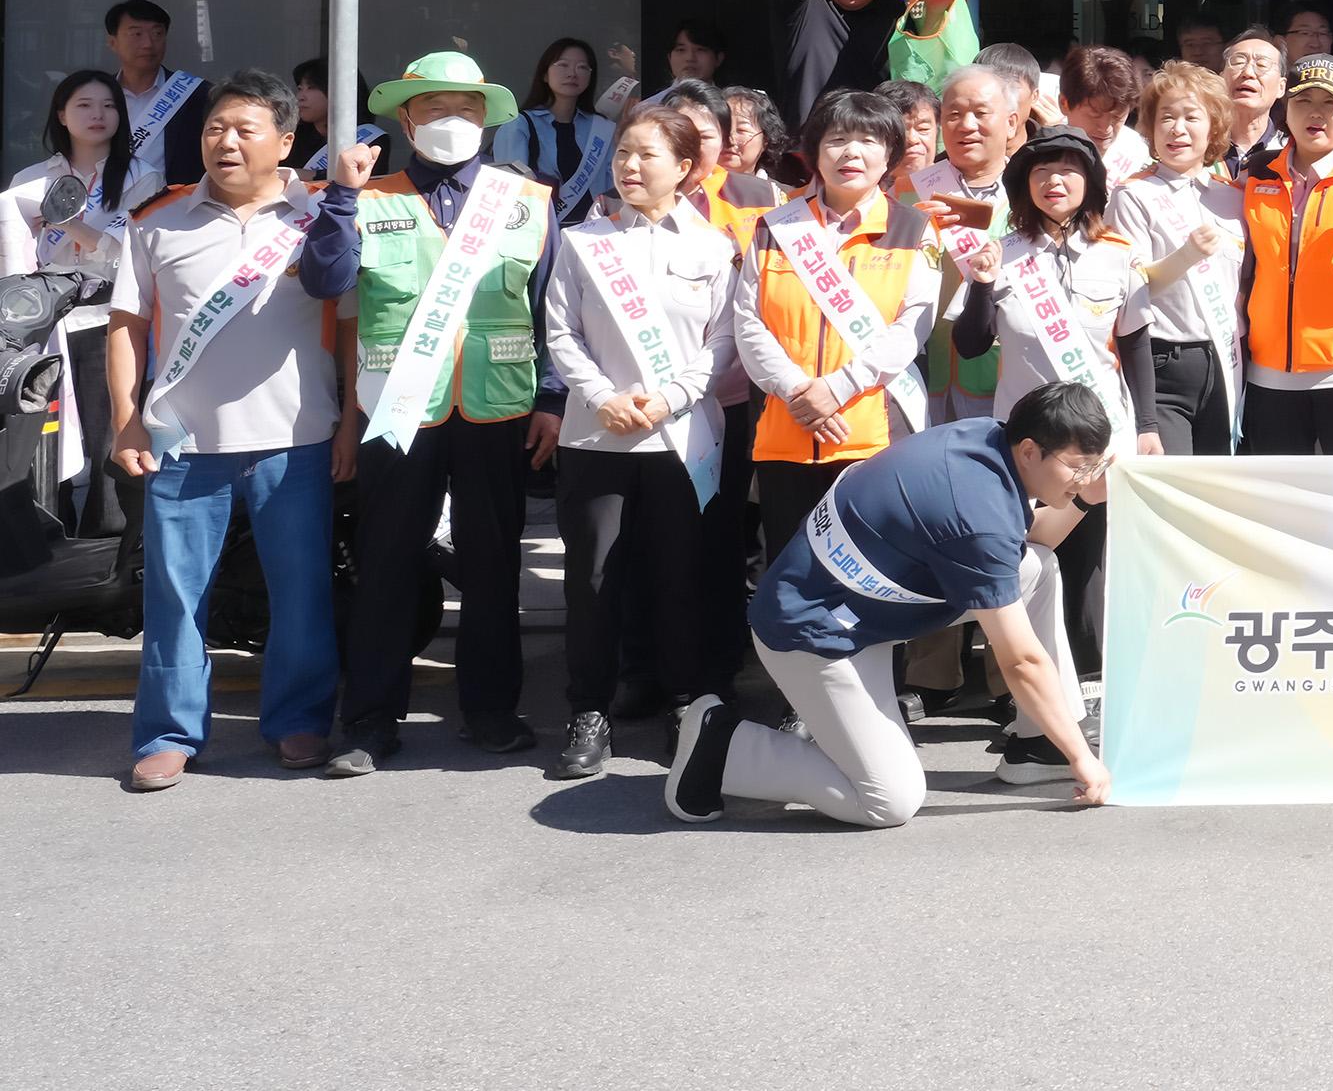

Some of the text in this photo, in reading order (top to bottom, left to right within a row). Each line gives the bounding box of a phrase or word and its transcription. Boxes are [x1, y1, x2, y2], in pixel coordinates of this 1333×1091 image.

[368, 219, 415, 234] 광주시방재단
[411, 175, 511, 359] 재난예방 안전실천
[586, 237, 649, 321] 재난예방
[791, 232, 856, 314] 재난예방
[1013, 255, 1072, 344] 재난예방
[167, 288, 234, 384] 안전실천
